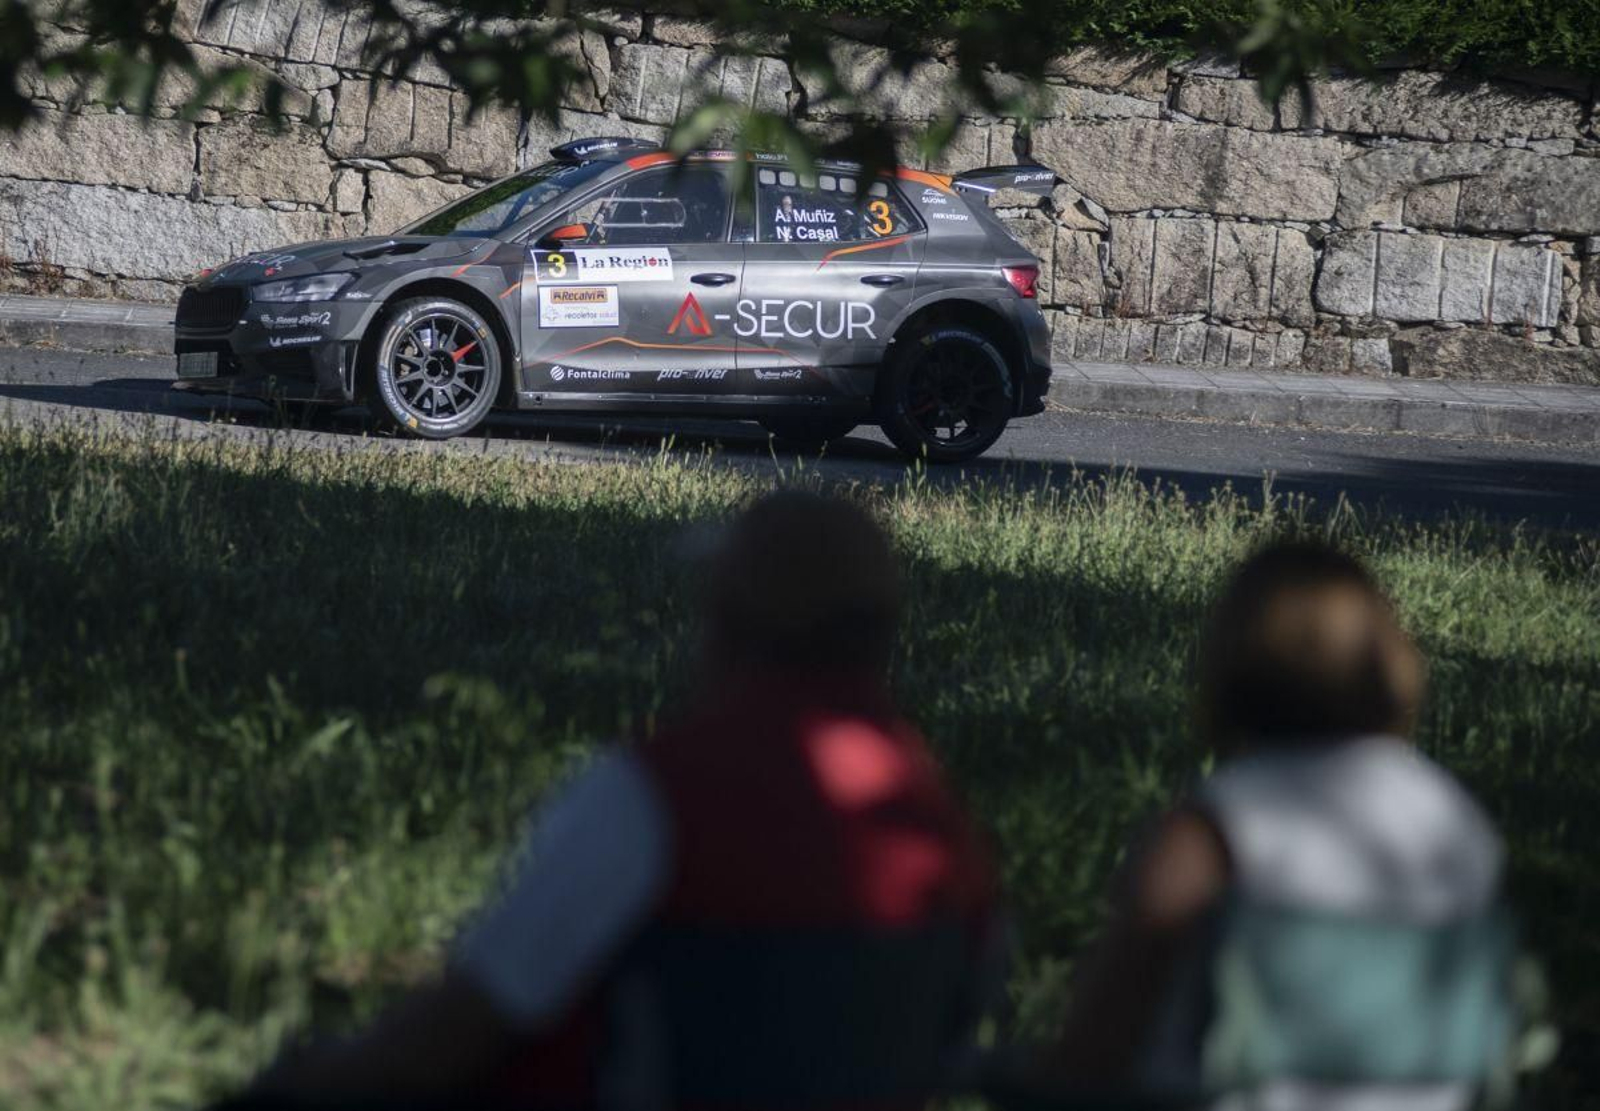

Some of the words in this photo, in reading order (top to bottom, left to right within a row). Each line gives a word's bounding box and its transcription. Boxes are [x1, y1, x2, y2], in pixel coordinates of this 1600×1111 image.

[793, 208, 837, 223] Muñiz
[870, 200, 893, 235] 3
[796, 226, 839, 240] Casal
[547, 253, 568, 279] 3
[581, 256, 605, 269] La
[567, 368, 631, 379] Fontalclima
